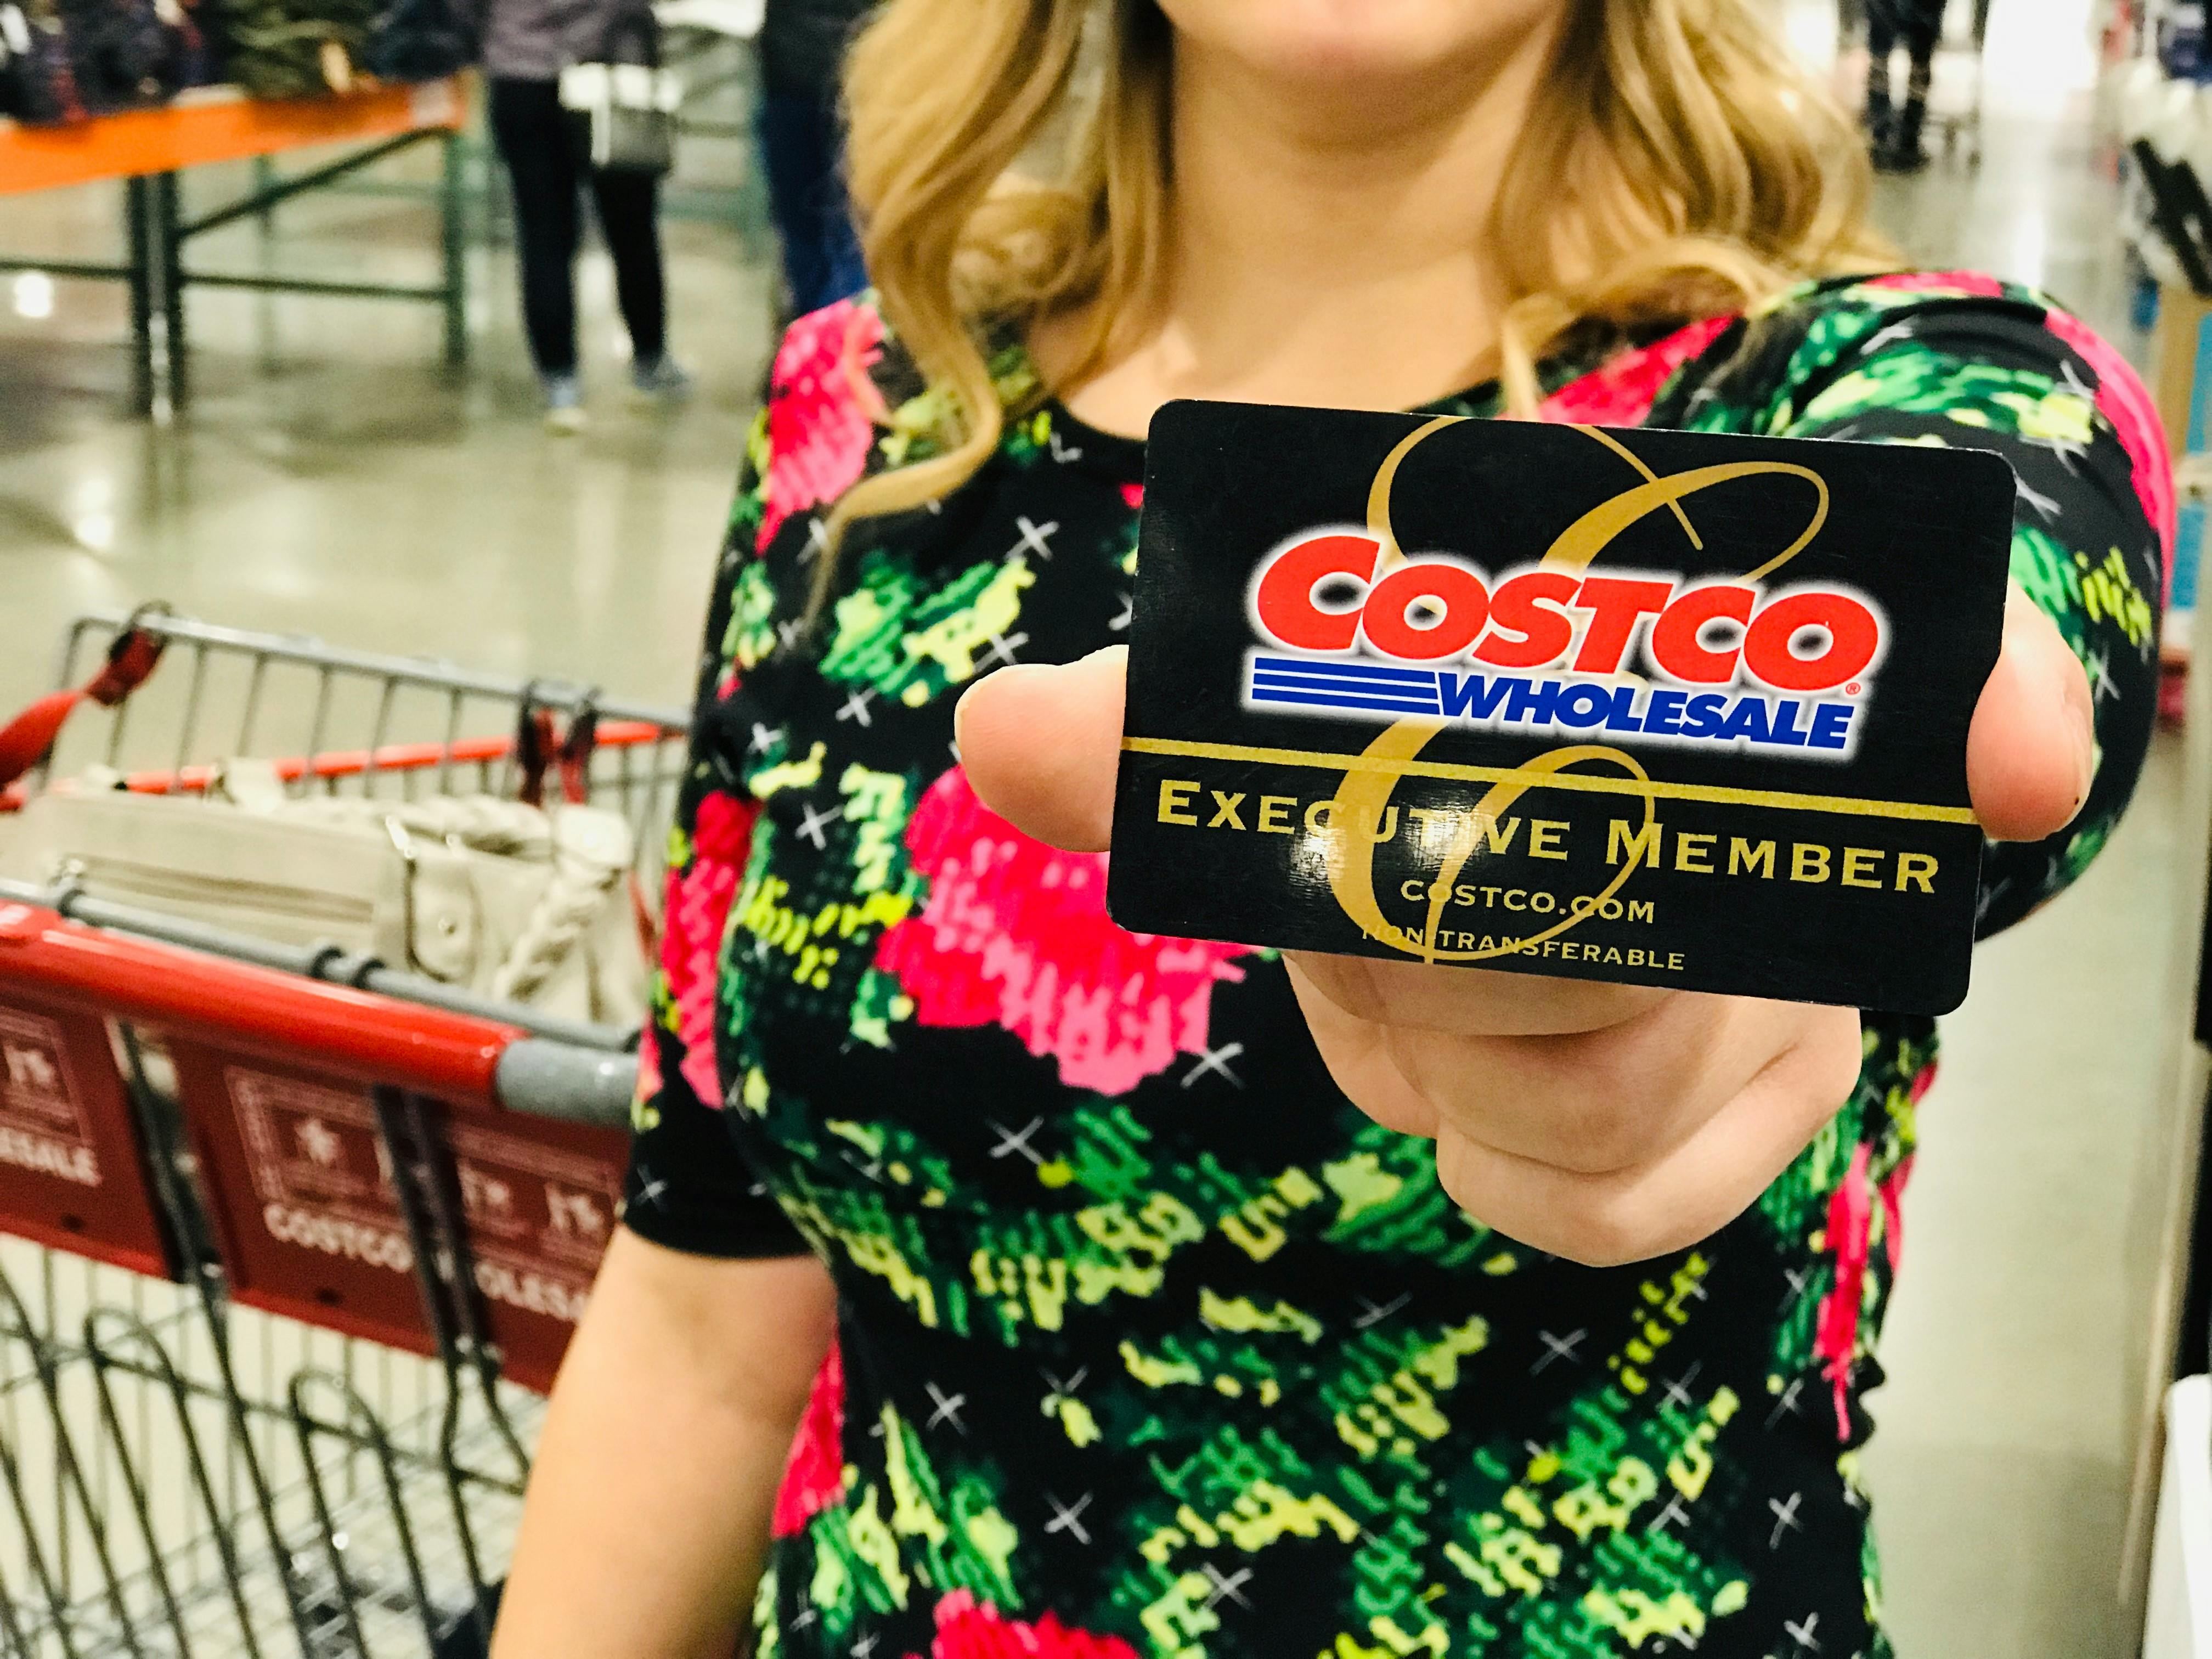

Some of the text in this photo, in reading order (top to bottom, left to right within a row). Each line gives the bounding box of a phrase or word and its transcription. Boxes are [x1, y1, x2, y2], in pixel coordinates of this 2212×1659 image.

[1257, 535, 1878, 691] COSTCO
[1439, 673, 1855, 749] WHOLESALE
[1157, 779, 1939, 894] EXECUTVE MEMBER
[1400, 879, 1655, 924] COSTCO.COM
